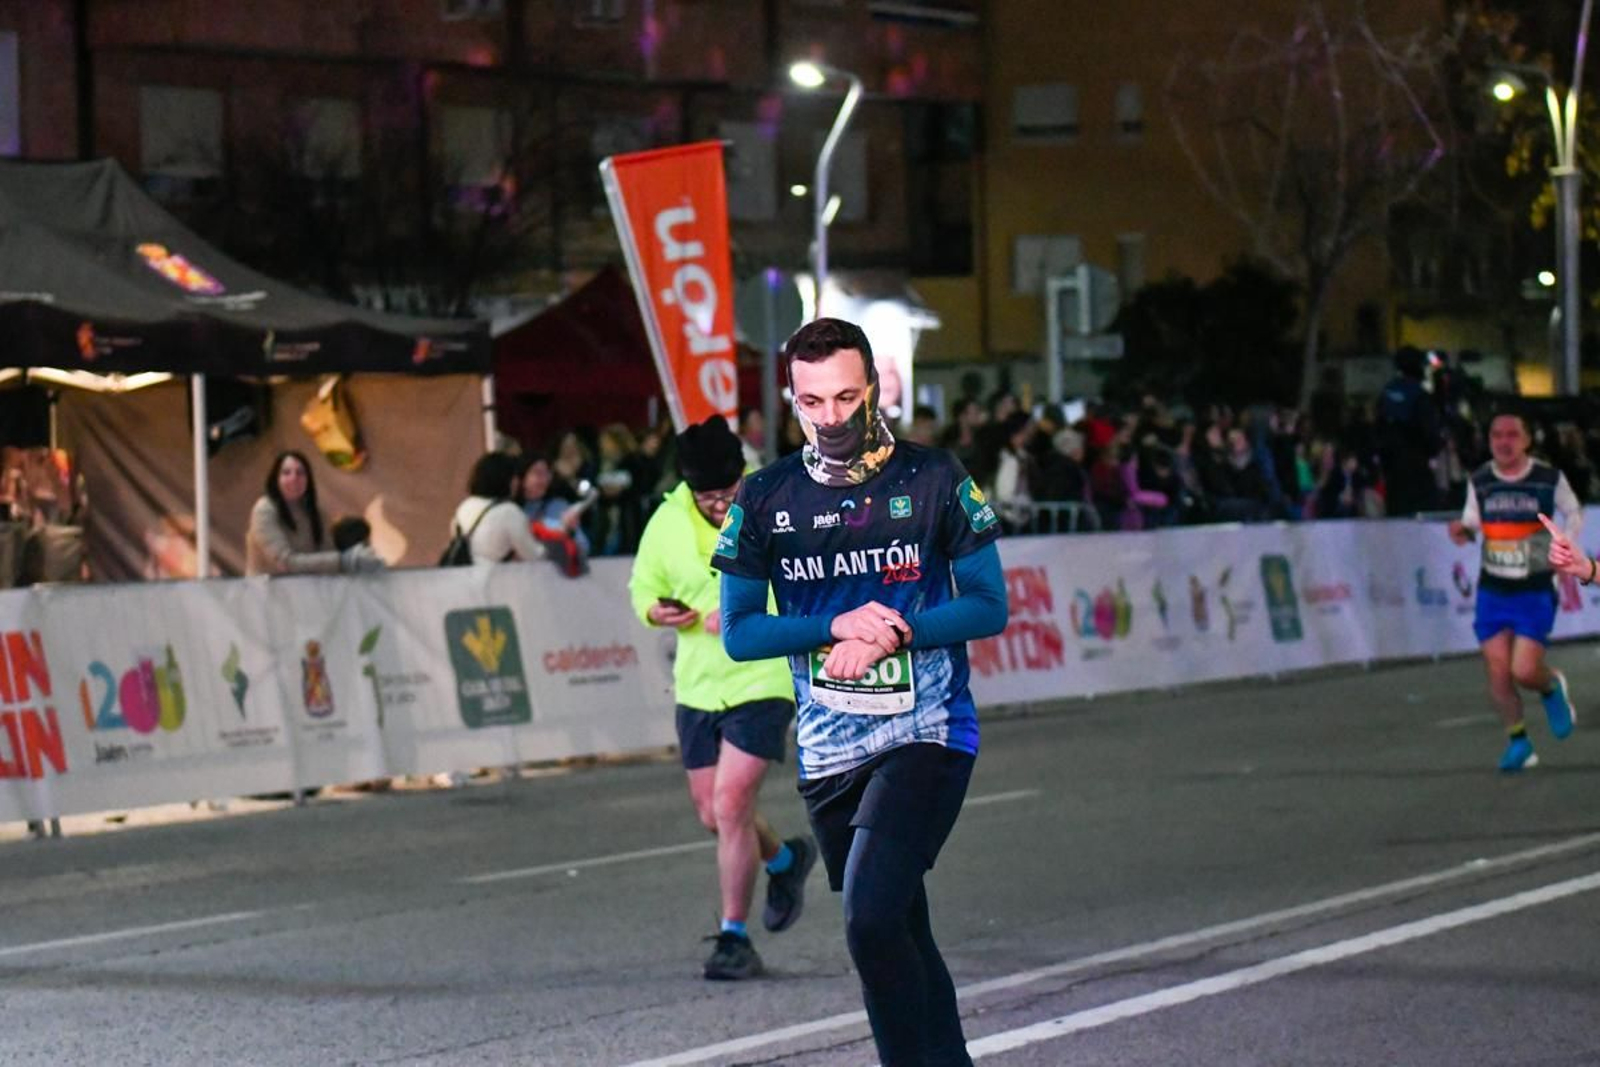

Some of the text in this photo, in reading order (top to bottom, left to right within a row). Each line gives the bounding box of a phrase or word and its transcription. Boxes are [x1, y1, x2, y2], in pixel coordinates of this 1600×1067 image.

[654, 205, 739, 432] erón
[813, 511, 840, 529] jaén
[781, 539, 919, 581] SAN ANTÓN
